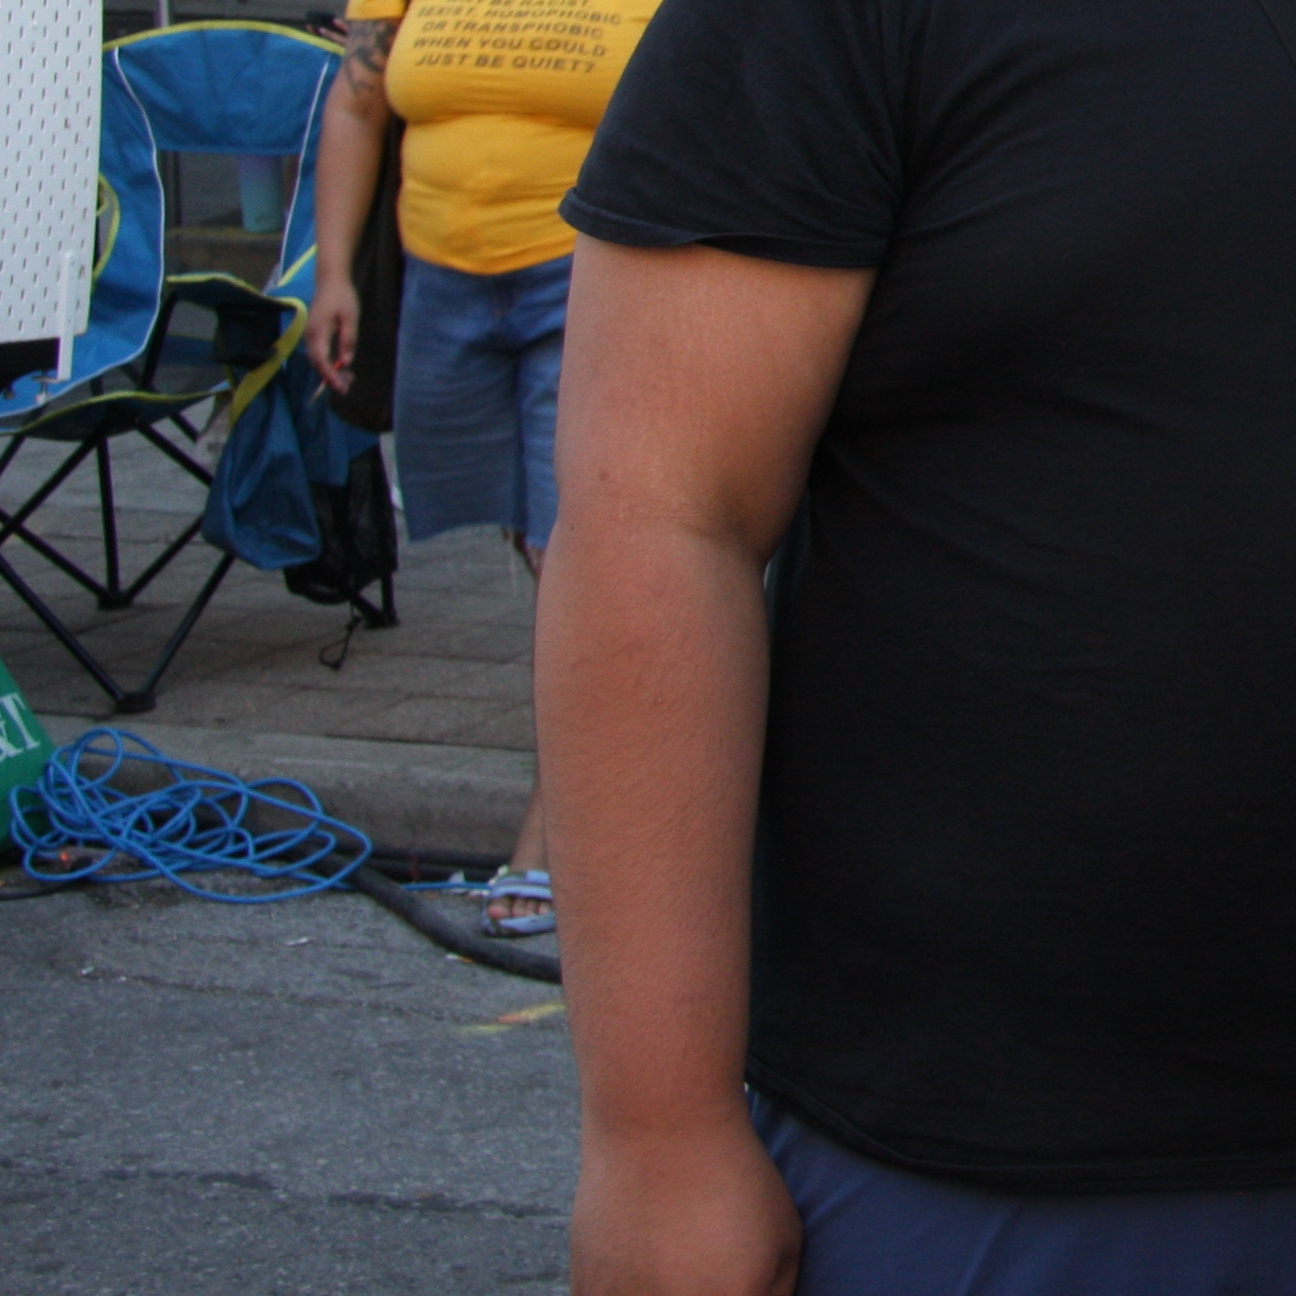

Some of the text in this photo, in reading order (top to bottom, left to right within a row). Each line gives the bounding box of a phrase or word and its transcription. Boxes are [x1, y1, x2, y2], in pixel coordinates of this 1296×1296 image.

[422, 21, 604, 39] OR TRANSPHOBIC
[414, 36, 607, 57] WHEN YOU COULD
[416, 54, 598, 73] JUST BE QUIET?
